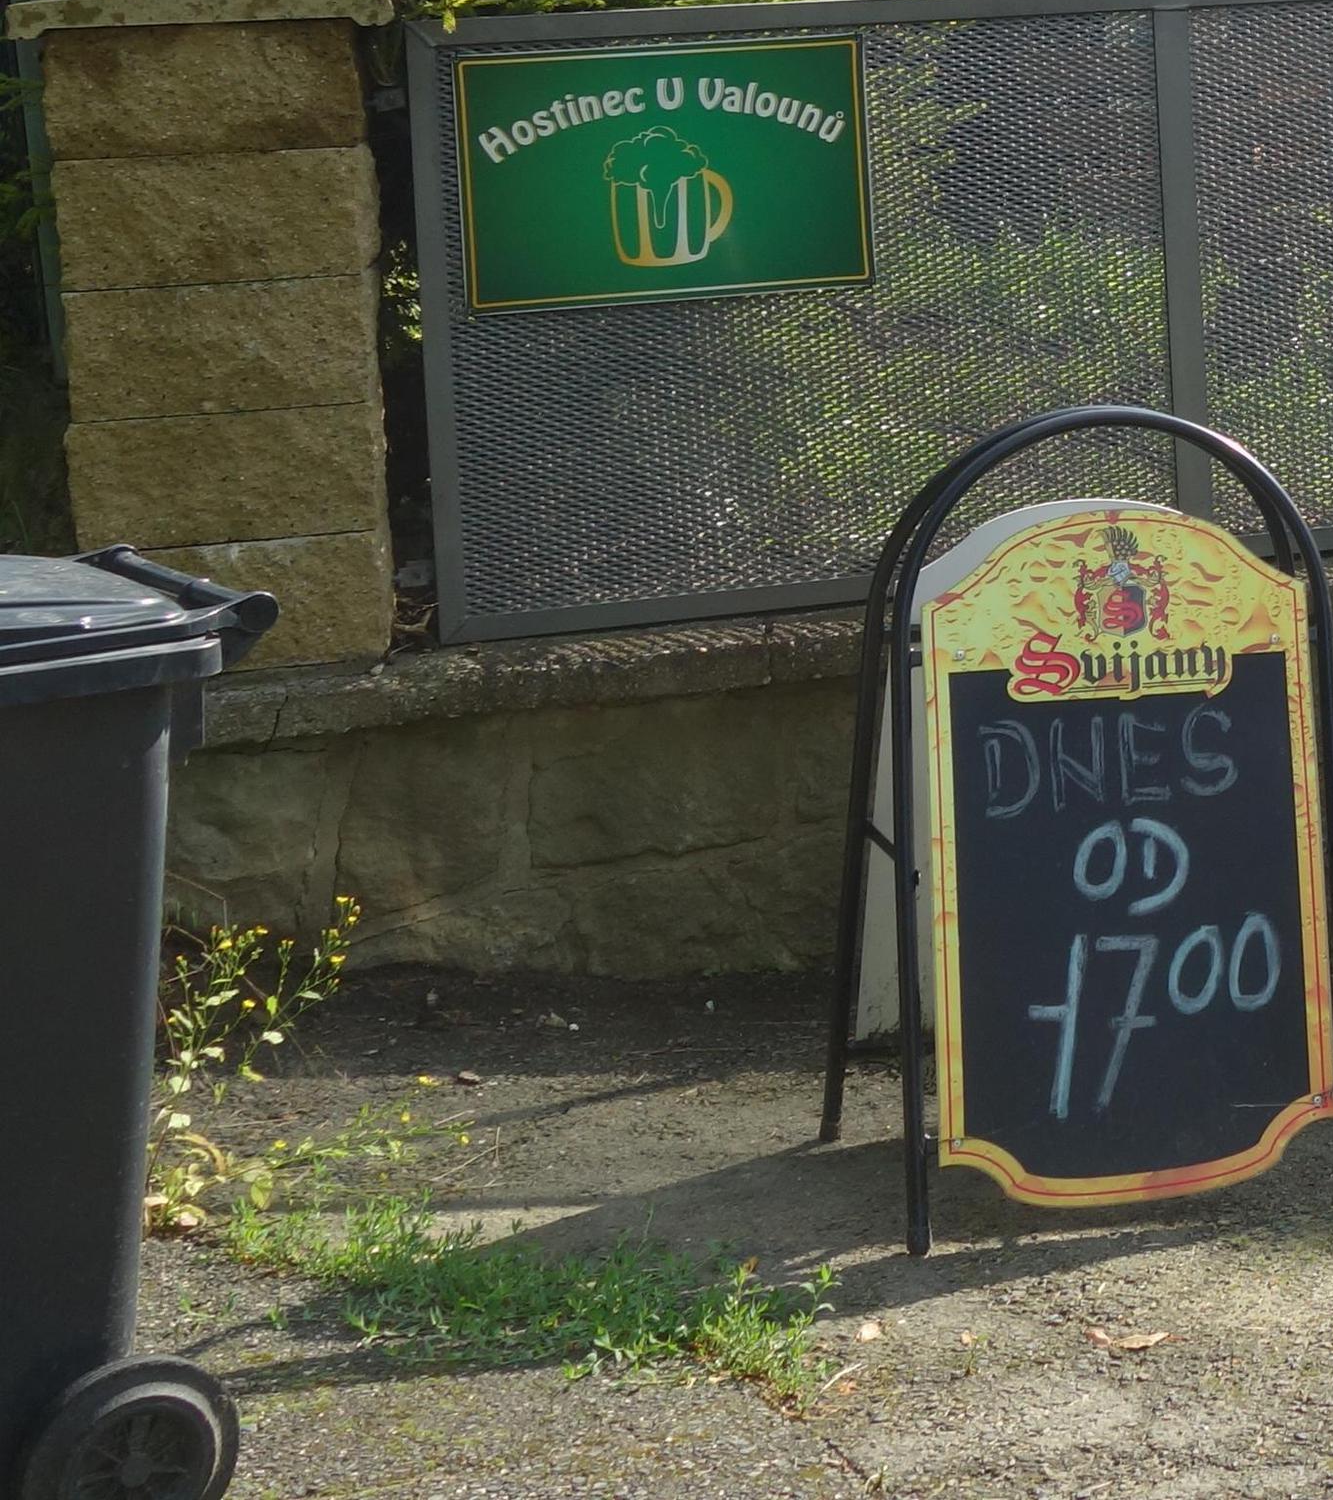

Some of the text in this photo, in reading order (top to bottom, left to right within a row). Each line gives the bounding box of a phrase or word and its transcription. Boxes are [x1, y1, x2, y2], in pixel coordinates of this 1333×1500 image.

[478, 77, 846, 163] Hostinec U Valounů
[1013, 632, 1226, 695] Svijany
[977, 703, 1239, 819] DNES
[1073, 815, 1190, 916] OD
